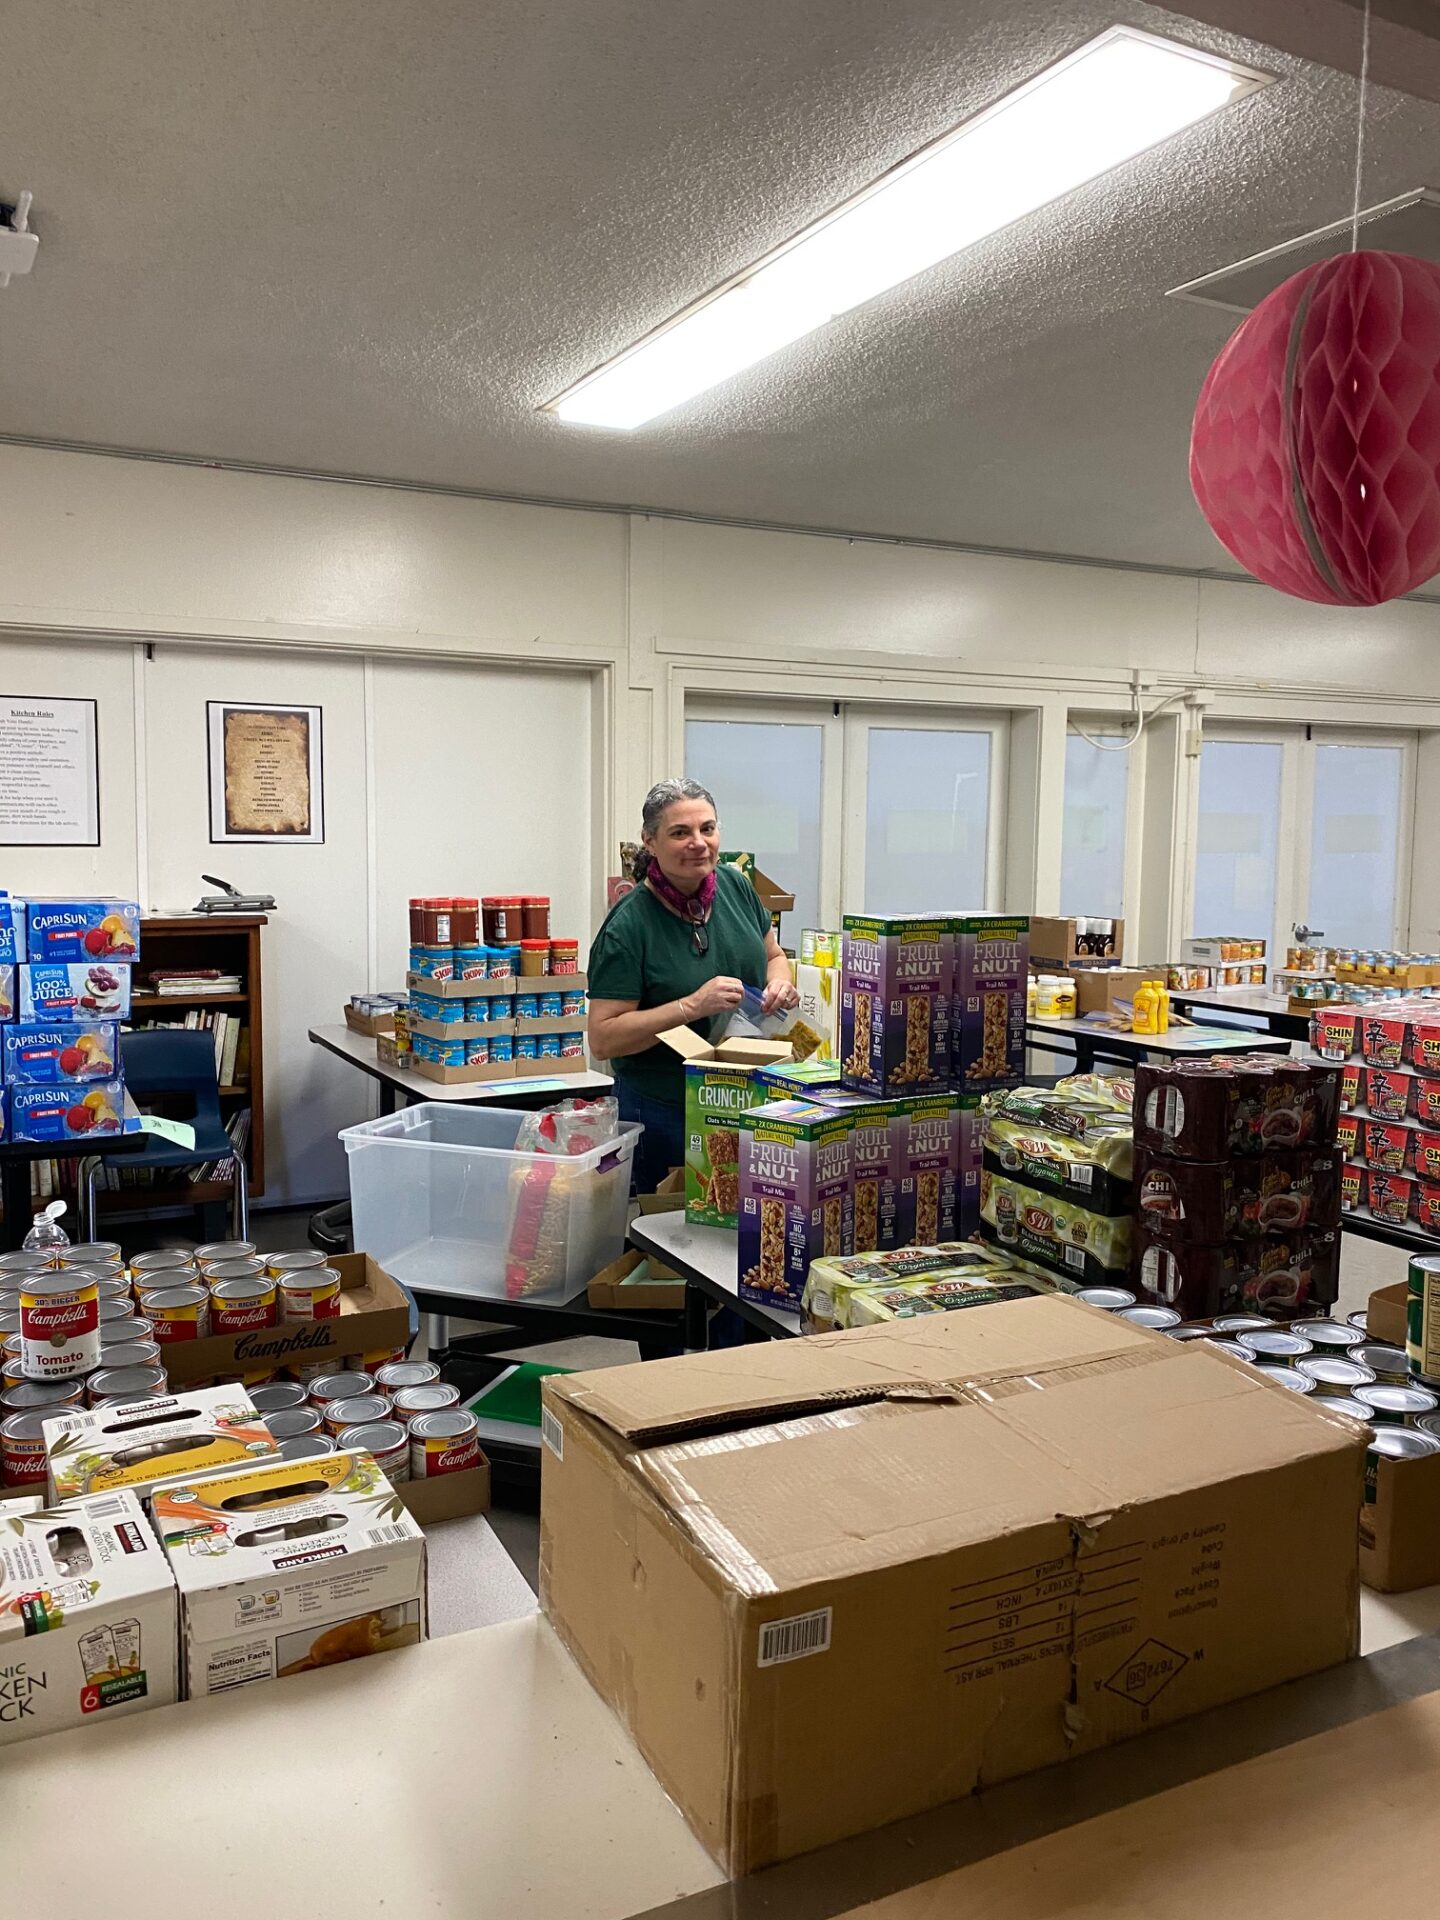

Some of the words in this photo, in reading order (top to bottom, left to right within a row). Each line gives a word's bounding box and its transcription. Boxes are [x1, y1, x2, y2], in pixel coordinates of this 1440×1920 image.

[990, 919, 1027, 928] CRANBERRIES
[33, 953, 42, 961] 10
[848, 940, 882, 960] FRUIT
[896, 943, 944, 962] FRUIT
[972, 942, 1022, 960] FRUIT
[35, 979, 67, 991] 100%
[30, 987, 73, 1001] JUICE
[968, 997, 978, 1005] 48
[892, 1001, 902, 1009] 48
[1326, 1027, 1352, 1037] SHIN
[776, 1079, 788, 1090] REAL
[1326, 1073, 1337, 1084] 8
[698, 1085, 754, 1109] CRUNCHY
[917, 1100, 924, 1108] 2X
[923, 1097, 958, 1107] CRANBERRIES
[1293, 1088, 1315, 1104] CHILI
[707, 1116, 720, 1124] Oats
[758, 1121, 766, 1129] 2X
[766, 1122, 805, 1136] CRANBERRIES
[908, 1120, 953, 1141] FRUIT
[691, 1135, 700, 1144] 49
[749, 1141, 800, 1167] FRUIT
[815, 1141, 851, 1168] FRUIT
[1027, 1162, 1059, 1179] Organic
[1323, 1160, 1334, 1170] 8
[1290, 1174, 1313, 1190] CHILI
[762, 1185, 776, 1194] Trail
[776, 1187, 786, 1197] Mix
[745, 1198, 755, 1208] 48
[793, 1223, 802, 1233] NO
[1324, 1231, 1335, 1242] 8
[1021, 1238, 1055, 1257] Organic
[1289, 1248, 1313, 1265] CHILI
[51, 1295, 80, 1305] BIGGER
[238, 1300, 262, 1308] BIGGER
[27, 1304, 87, 1328] Campbell's
[218, 1307, 269, 1327] Campbell's
[234, 1325, 337, 1360] Campbell's
[36, 1352, 84, 1365] Tomato
[43, 1365, 76, 1376] SOUP
[118, 1399, 176, 1414] KIRKLAND
[14, 1444, 44, 1452] BIGGER
[101, 1531, 118, 1553] ORGANIC
[123, 1523, 145, 1551] KIRKLAND
[89, 1526, 104, 1553] CHICKEN
[98, 1547, 113, 1565] STOCK
[283, 1542, 331, 1557] ORGANIC
[276, 1548, 346, 1568] KIRKLAND
[996, 1594, 1022, 1610] INCH
[998, 1614, 1020, 1629] LBS
[1055, 1622, 1065, 1634] 12
[992, 1637, 1016, 1653] SETS
[209, 1656, 246, 1672] Nutrition
[247, 1650, 271, 1661] Facts
[996, 1654, 1038, 1671] THERMAL
[102, 1675, 143, 1692] RESEALABLE
[1093, 1679, 1102, 1691] A
[83, 1689, 98, 1709] 6
[105, 1687, 141, 1705] CARTONS
